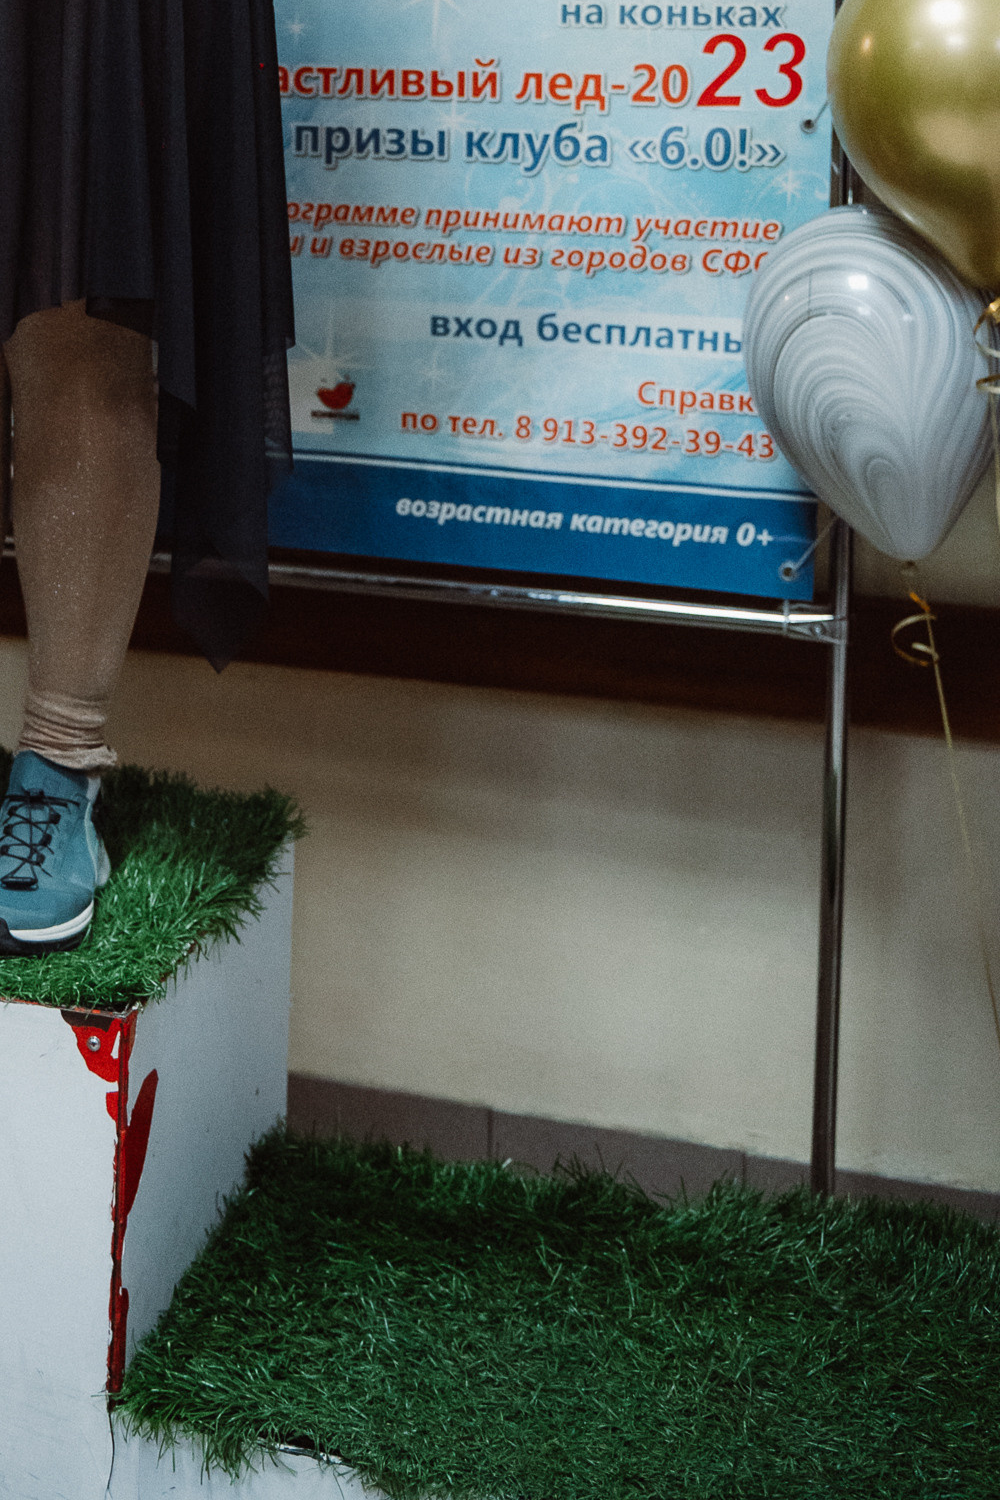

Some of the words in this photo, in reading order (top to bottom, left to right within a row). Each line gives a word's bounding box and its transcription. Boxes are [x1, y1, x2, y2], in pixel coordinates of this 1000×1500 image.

[560, 2, 603, 26] на
[618, 4, 782, 28] коньках
[278, 59, 498, 100] астливый
[295, 124, 446, 162] призы
[466, 122, 608, 171] клуба
[629, 127, 784, 167] «6.0!»
[287, 201, 416, 228] ограмме
[425, 207, 624, 238] принимают
[632, 214, 781, 244] участие
[310, 236, 329, 255] и
[339, 237, 491, 266] взрослые
[503, 245, 538, 267] из
[551, 246, 688, 276] городов
[431, 314, 523, 346] вход
[637, 381, 755, 416] Справк
[402, 411, 438, 434] по
[449, 416, 503, 438] тел.
[515, 415, 531, 439] 8
[542, 417, 776, 459] 913-392-39-43
[396, 498, 563, 531] возрастная
[570, 512, 729, 546] категория
[736, 522, 774, 547] 0+
